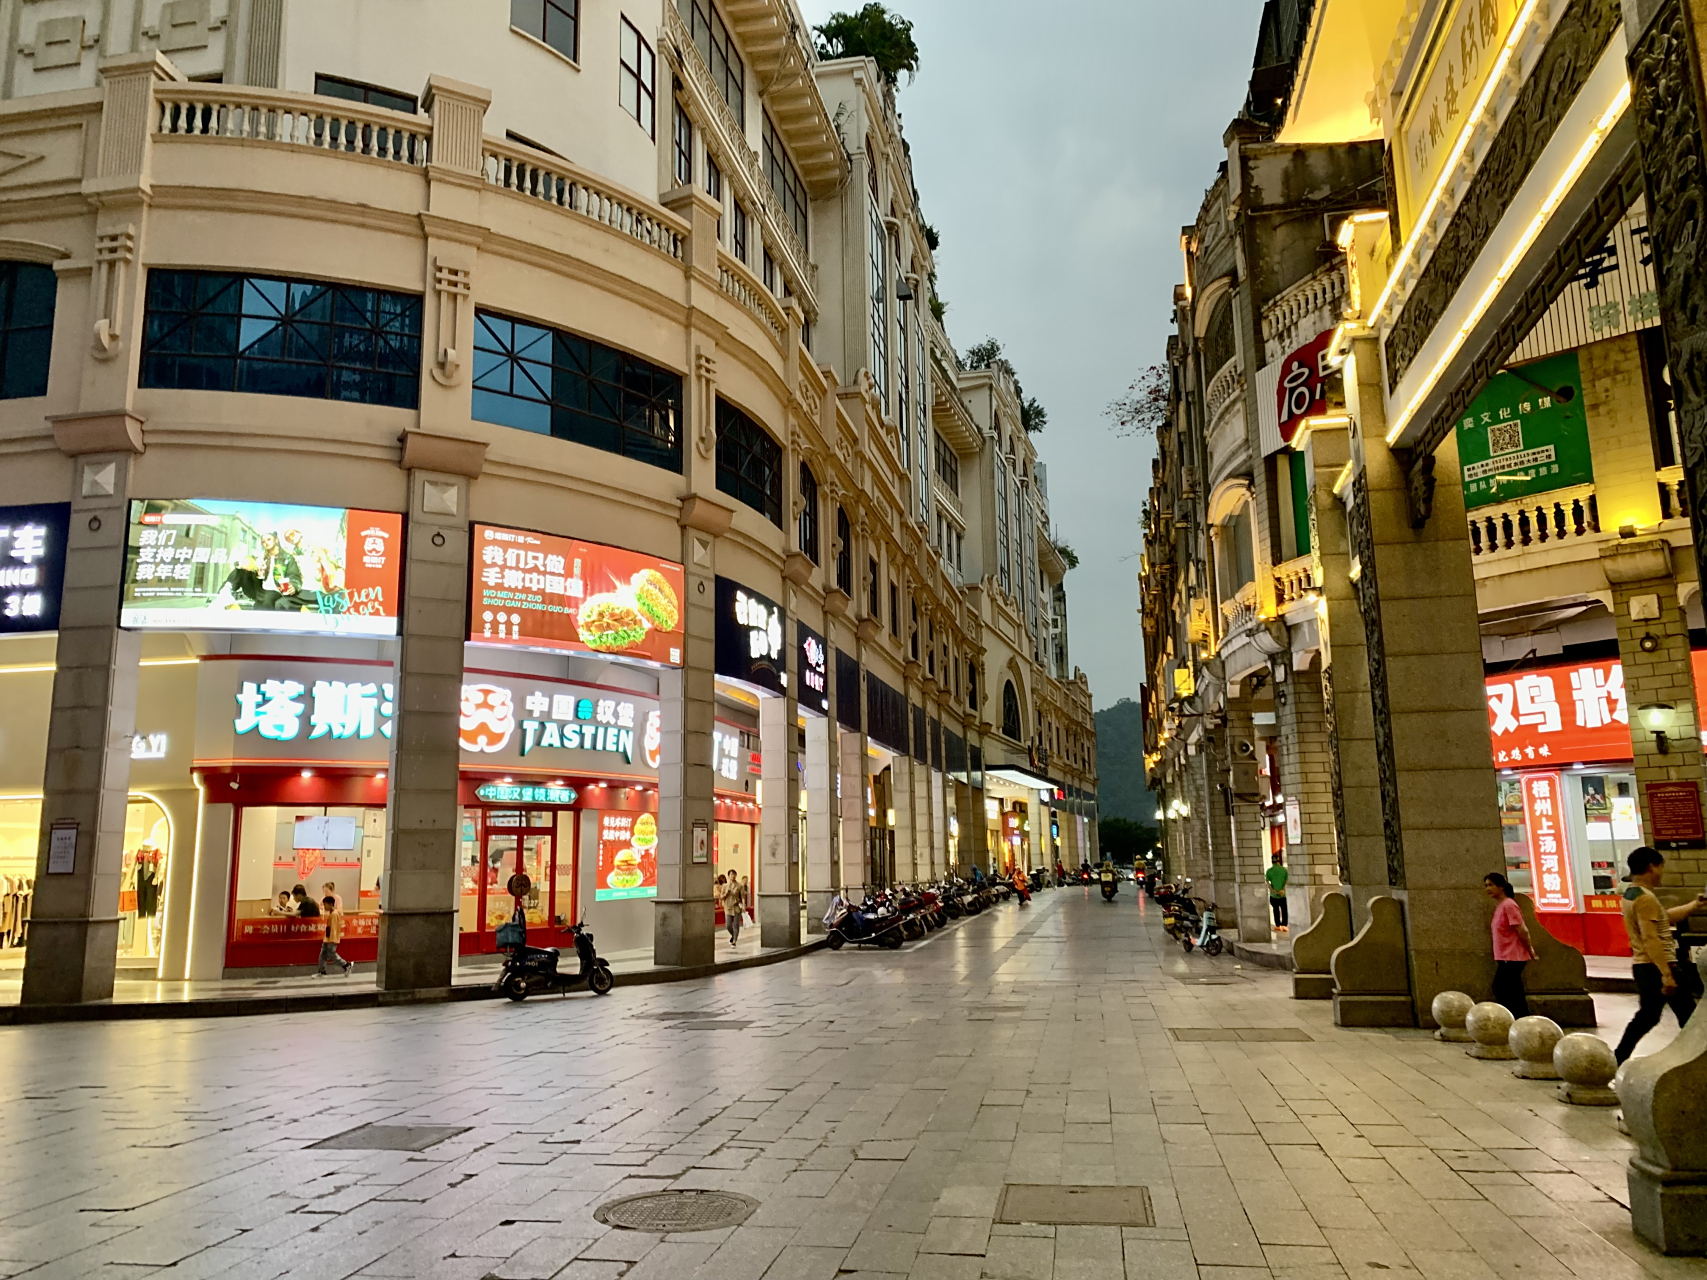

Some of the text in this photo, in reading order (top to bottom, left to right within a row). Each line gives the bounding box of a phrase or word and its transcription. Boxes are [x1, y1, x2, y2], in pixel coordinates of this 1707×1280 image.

[0, 525, 46, 564] 车
[139, 529, 177, 546] 我们
[136, 546, 242, 563] 支持中国品
[482, 545, 565, 575] 我们只做
[136, 563, 192, 580] 我年轻
[483, 589, 496, 597] WO
[497, 591, 513, 599] MEN
[527, 594, 542, 602] ZUO
[483, 597, 504, 606] SHOU
[505, 600, 521, 608] GAN
[522, 602, 547, 611] ZHONG
[548, 604, 563, 613] GUO
[520, 720, 635, 764] TASTIEN
[1531, 780, 1562, 892] 梧州上汤河粉
